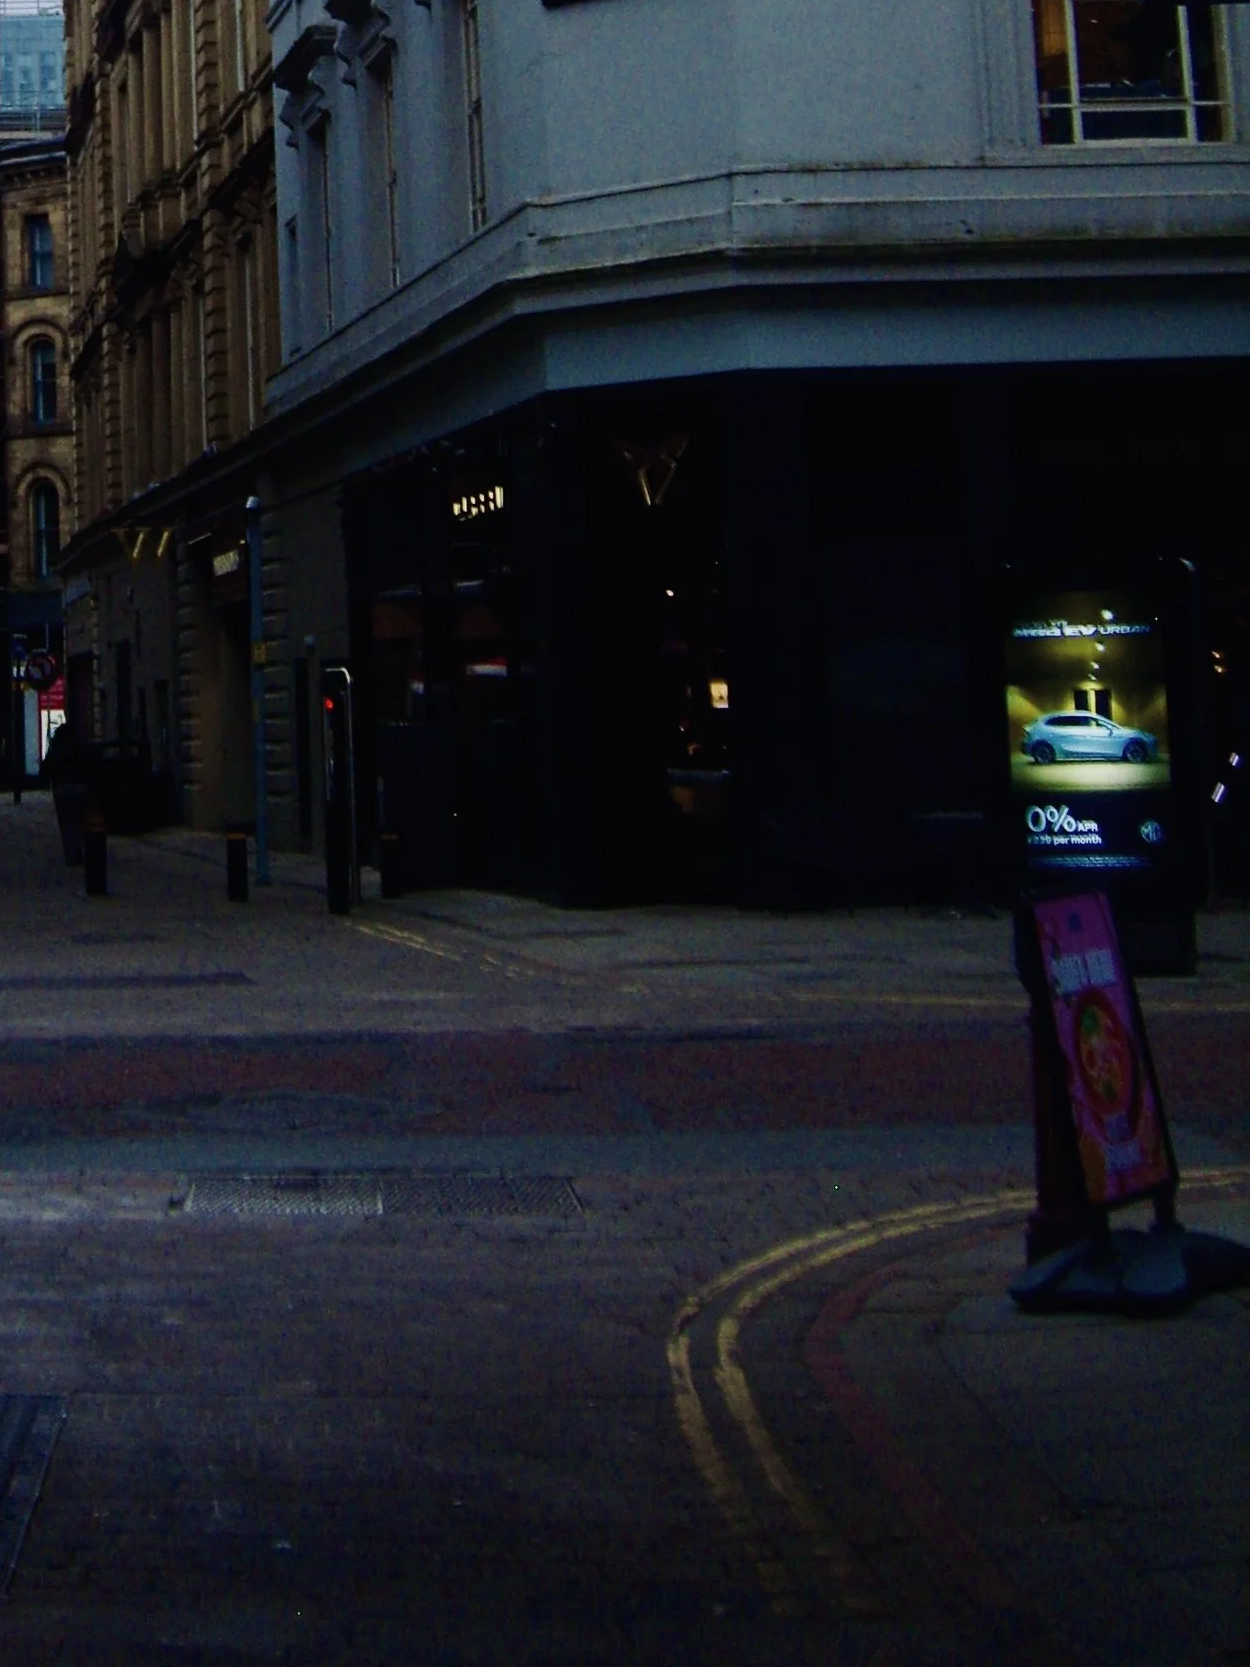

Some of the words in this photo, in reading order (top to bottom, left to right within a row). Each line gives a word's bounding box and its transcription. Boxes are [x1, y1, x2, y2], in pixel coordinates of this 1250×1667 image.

[1027, 804, 1077, 832] 0%
[1077, 819, 1099, 832] APR
[1053, 835, 1070, 847] per
[1070, 834, 1102, 845] month
